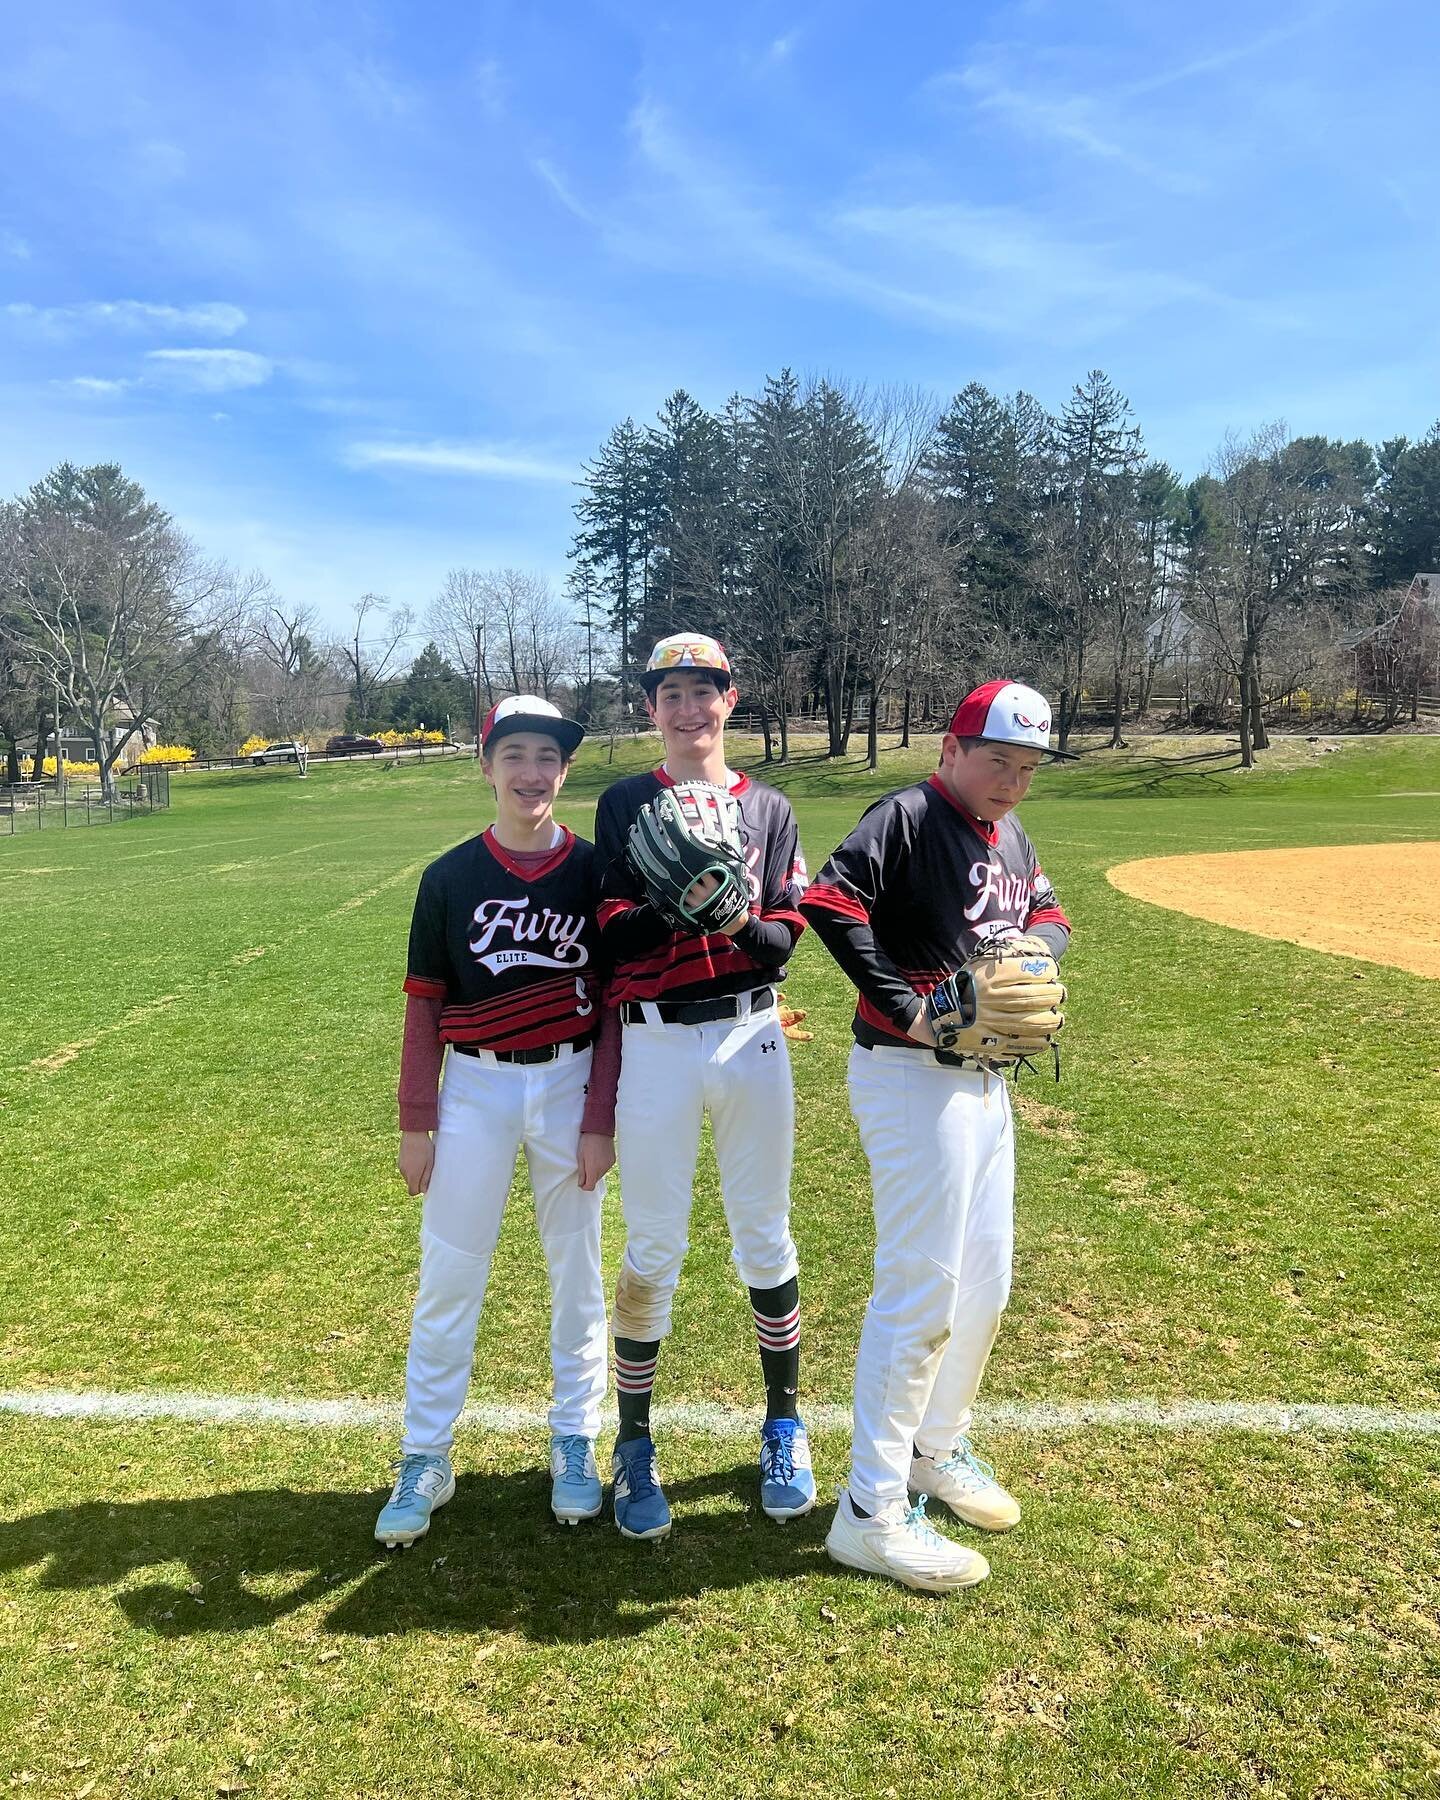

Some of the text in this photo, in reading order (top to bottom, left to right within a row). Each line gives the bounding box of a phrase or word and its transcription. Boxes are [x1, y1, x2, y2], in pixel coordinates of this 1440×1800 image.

[964, 861, 1031, 929] Fury
[469, 896, 588, 962] Fury
[496, 953, 527, 963] ELITE
